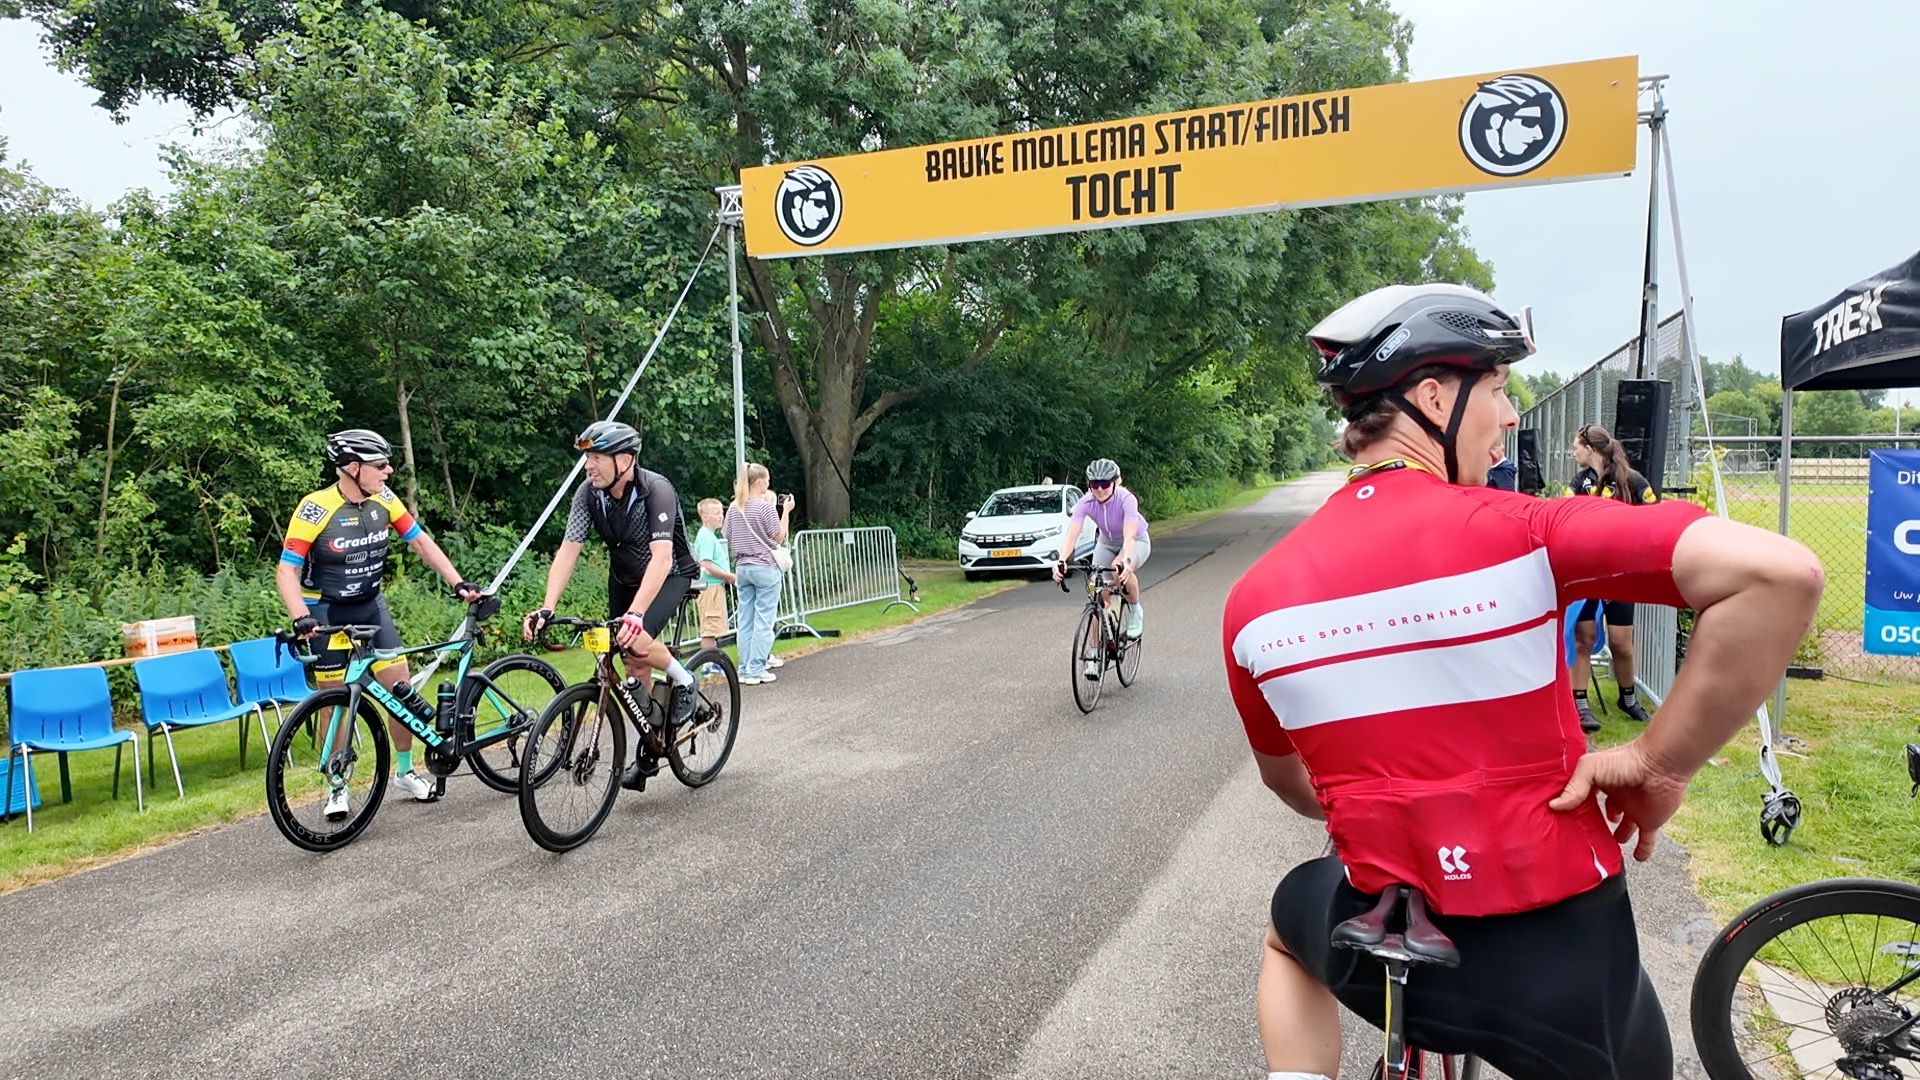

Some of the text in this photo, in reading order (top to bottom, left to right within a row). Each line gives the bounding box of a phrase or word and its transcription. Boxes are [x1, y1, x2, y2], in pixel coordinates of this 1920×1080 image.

[926, 95, 1351, 183] BAUKE MOLLEMA START/FINISH
[1066, 163, 1182, 221] TOCHT
[1812, 281, 1895, 357] TREK
[1893, 590, 1914, 600] Uw
[1260, 600, 1498, 653] CYCLE SPORT GRONINGEN
[366, 680, 444, 747] Bianchi
[616, 680, 652, 733] S-WORKS
